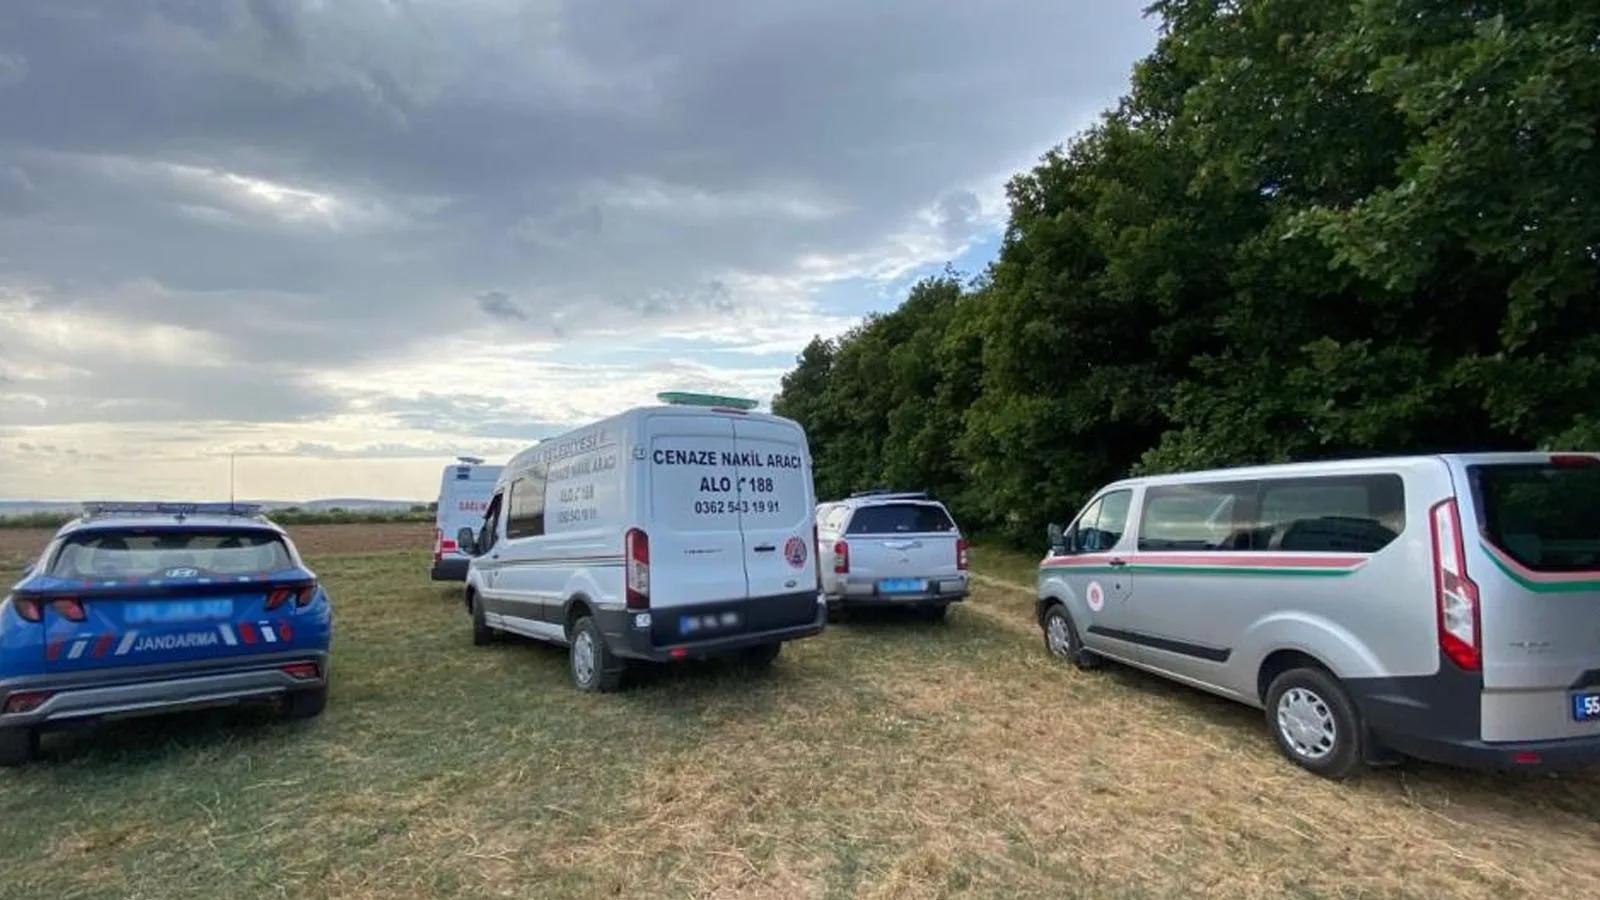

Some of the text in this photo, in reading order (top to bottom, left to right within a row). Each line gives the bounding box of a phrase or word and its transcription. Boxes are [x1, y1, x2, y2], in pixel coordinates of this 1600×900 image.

[653, 450, 801, 469] CENAZE NAKİL ARACI
[700, 477, 773, 492] ALO 188
[695, 501, 779, 514] 0362 543 19 91
[135, 631, 218, 652] JANDARMA
[1584, 696, 1600, 715] 55
